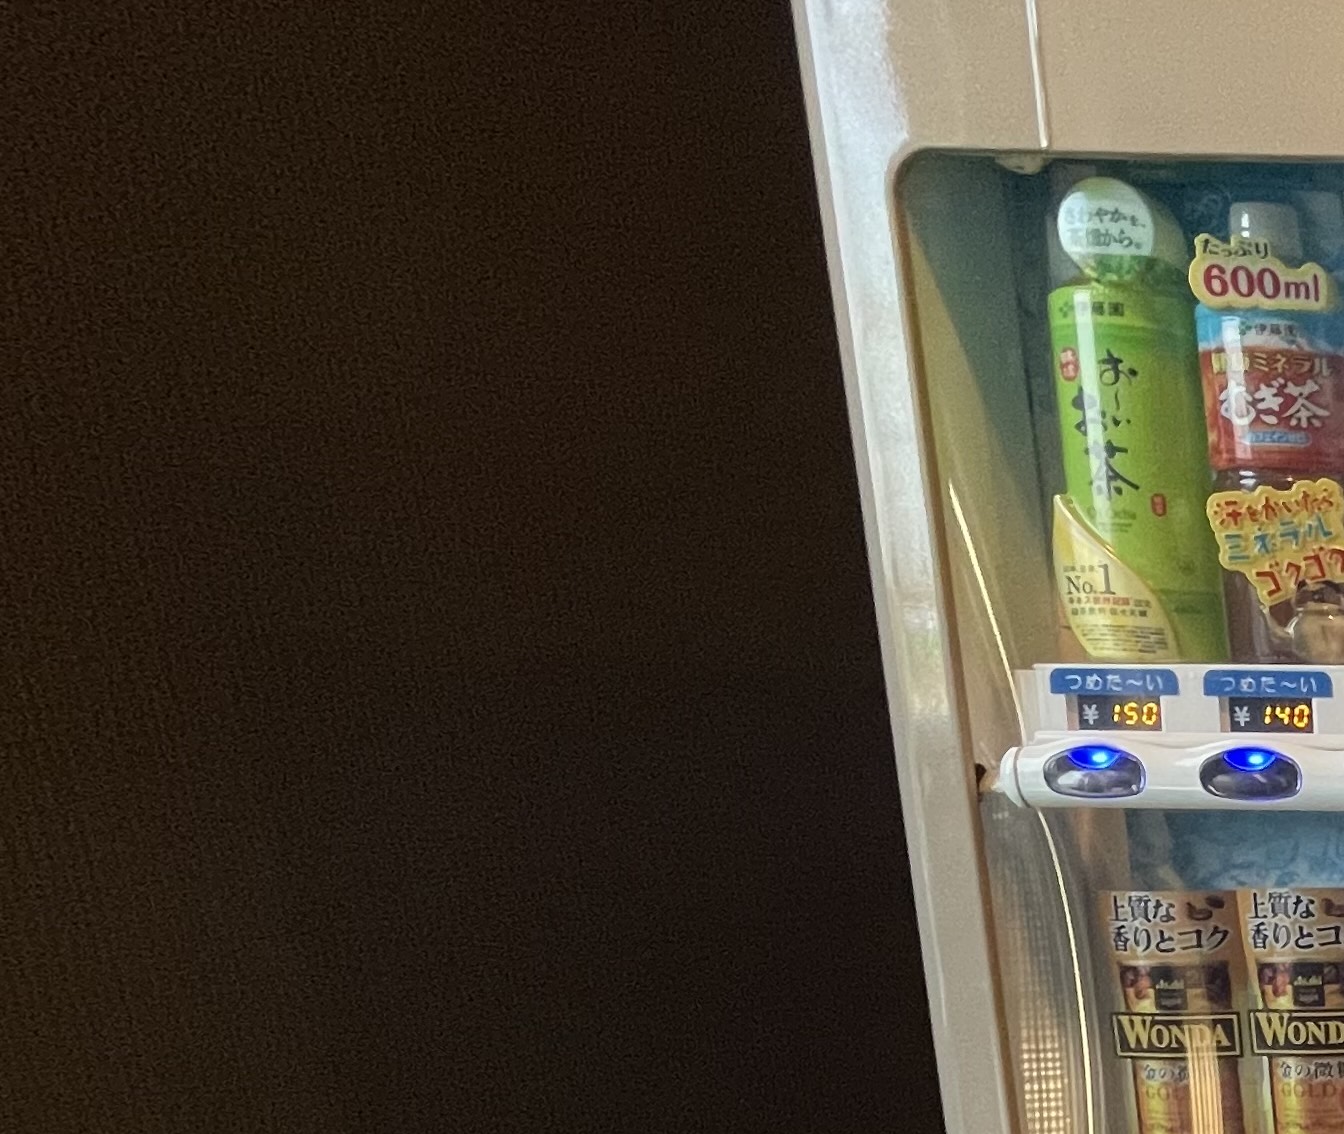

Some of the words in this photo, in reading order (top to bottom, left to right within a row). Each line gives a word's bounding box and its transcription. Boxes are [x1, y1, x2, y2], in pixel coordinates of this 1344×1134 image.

[1204, 266, 1321, 302] 600ml
[1219, 384, 1332, 428] むぎ茶
[1223, 520, 1334, 562] ミネラル
[1111, 894, 1177, 923] 上質な
[1249, 891, 1317, 920] 上質な
[1112, 925, 1231, 953] 香りとコク
